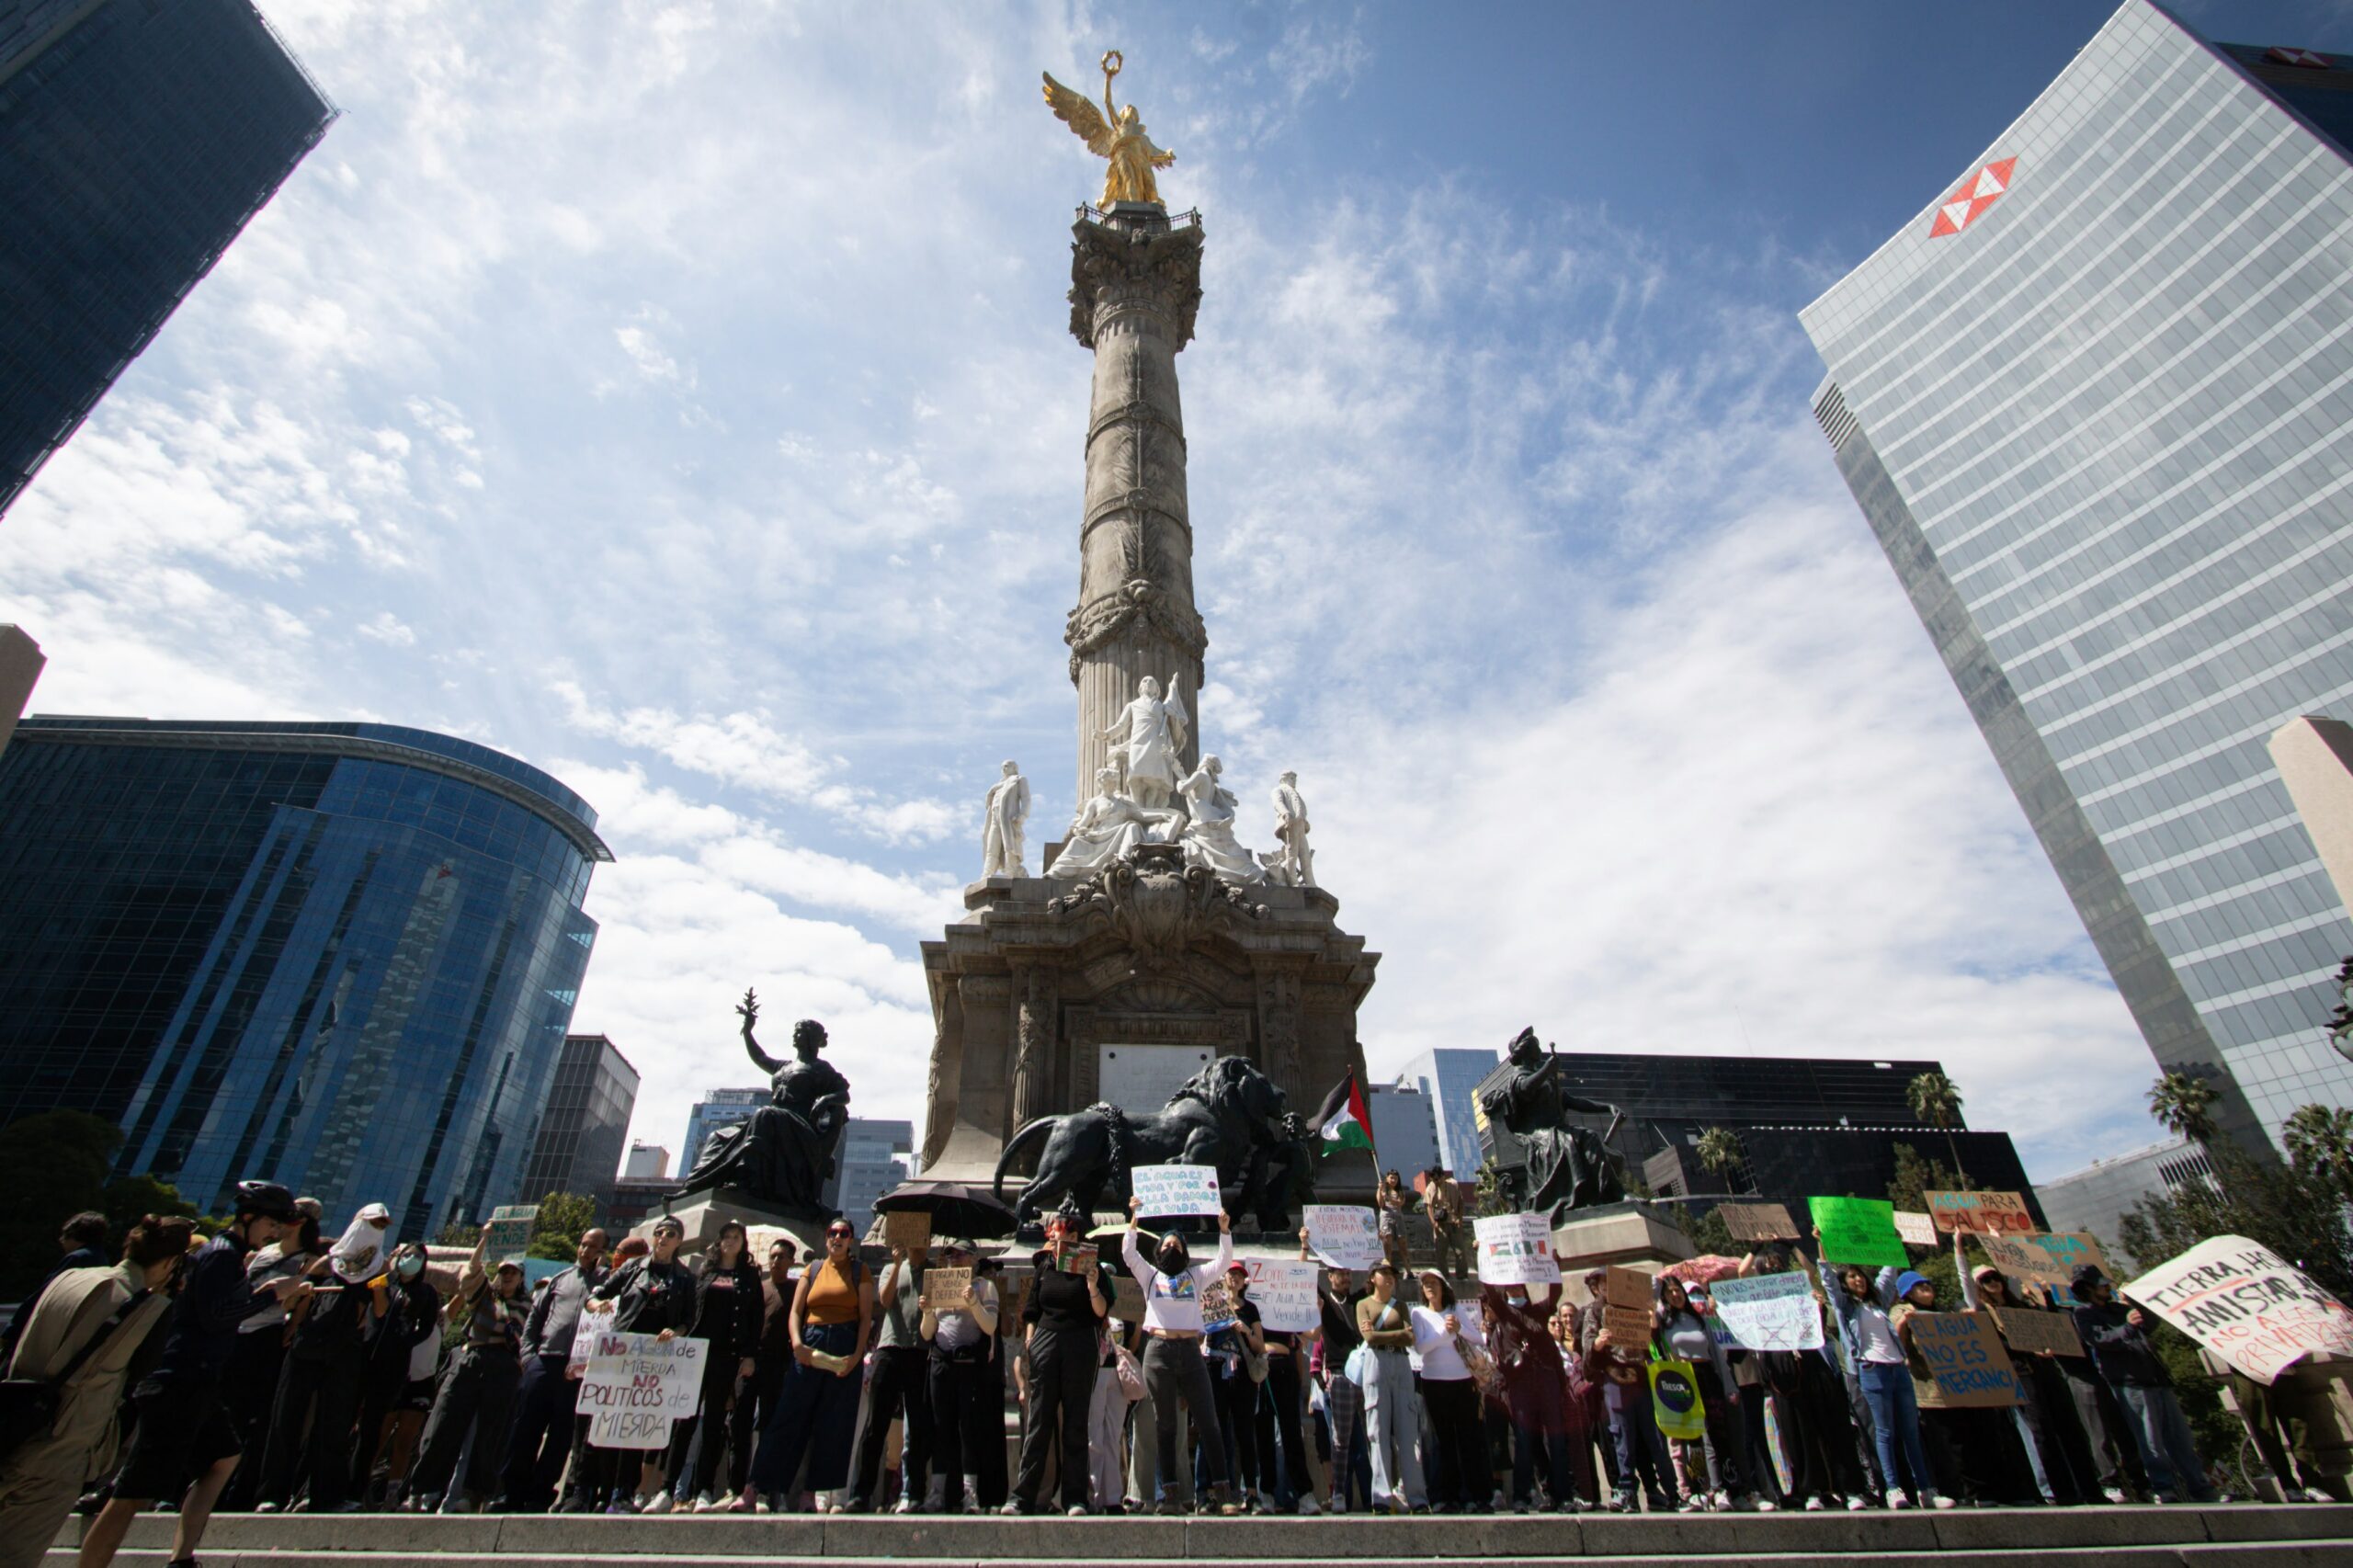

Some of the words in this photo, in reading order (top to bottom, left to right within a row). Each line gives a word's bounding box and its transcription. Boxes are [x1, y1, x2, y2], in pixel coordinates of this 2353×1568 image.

[1134, 1172, 1152, 1183] EL
[1154, 1170, 1188, 1182] AGUA
[1188, 1170, 1203, 1181] ES
[1135, 1183, 1165, 1194] VIDA
[1166, 1181, 1175, 1190] Y
[1177, 1180, 1200, 1190] POR
[1934, 1192, 1982, 1210] AGUA
[1980, 1194, 2019, 1210] PARA
[510, 1207, 536, 1220] AGUA
[1144, 1205, 1163, 1215] LA
[1165, 1202, 1200, 1214] VIDA
[493, 1222, 509, 1233] NO
[1896, 1215, 1932, 1229] DIGNA
[1936, 1210, 2031, 1232] JALISCO
[487, 1233, 527, 1246] VENDE
[1903, 1228, 1935, 1242] UEBLO
[1322, 1237, 1341, 1248] AGUA
[1994, 1253, 2011, 1267] NO
[926, 1271, 933, 1279] EL
[936, 1271, 955, 1279] AGUA
[957, 1269, 970, 1279] NO
[1276, 1293, 1294, 1303] AGUA
[2180, 1277, 2302, 1336] AMISTAD
[1910, 1318, 1936, 1338] EL
[1934, 1314, 1981, 1337] AGUA
[2211, 1325, 2251, 1349] NO
[2256, 1314, 2280, 1331] A
[2278, 1306, 2319, 1322] LA
[629, 1337, 676, 1359] AGUA
[676, 1342, 697, 1359] de
[1922, 1344, 1956, 1364] NO
[1957, 1340, 1988, 1365] ES
[632, 1374, 661, 1389] NO
[579, 1383, 665, 1408] POLITICOS
[667, 1385, 691, 1411] de
[595, 1412, 667, 1440] MIERDA
